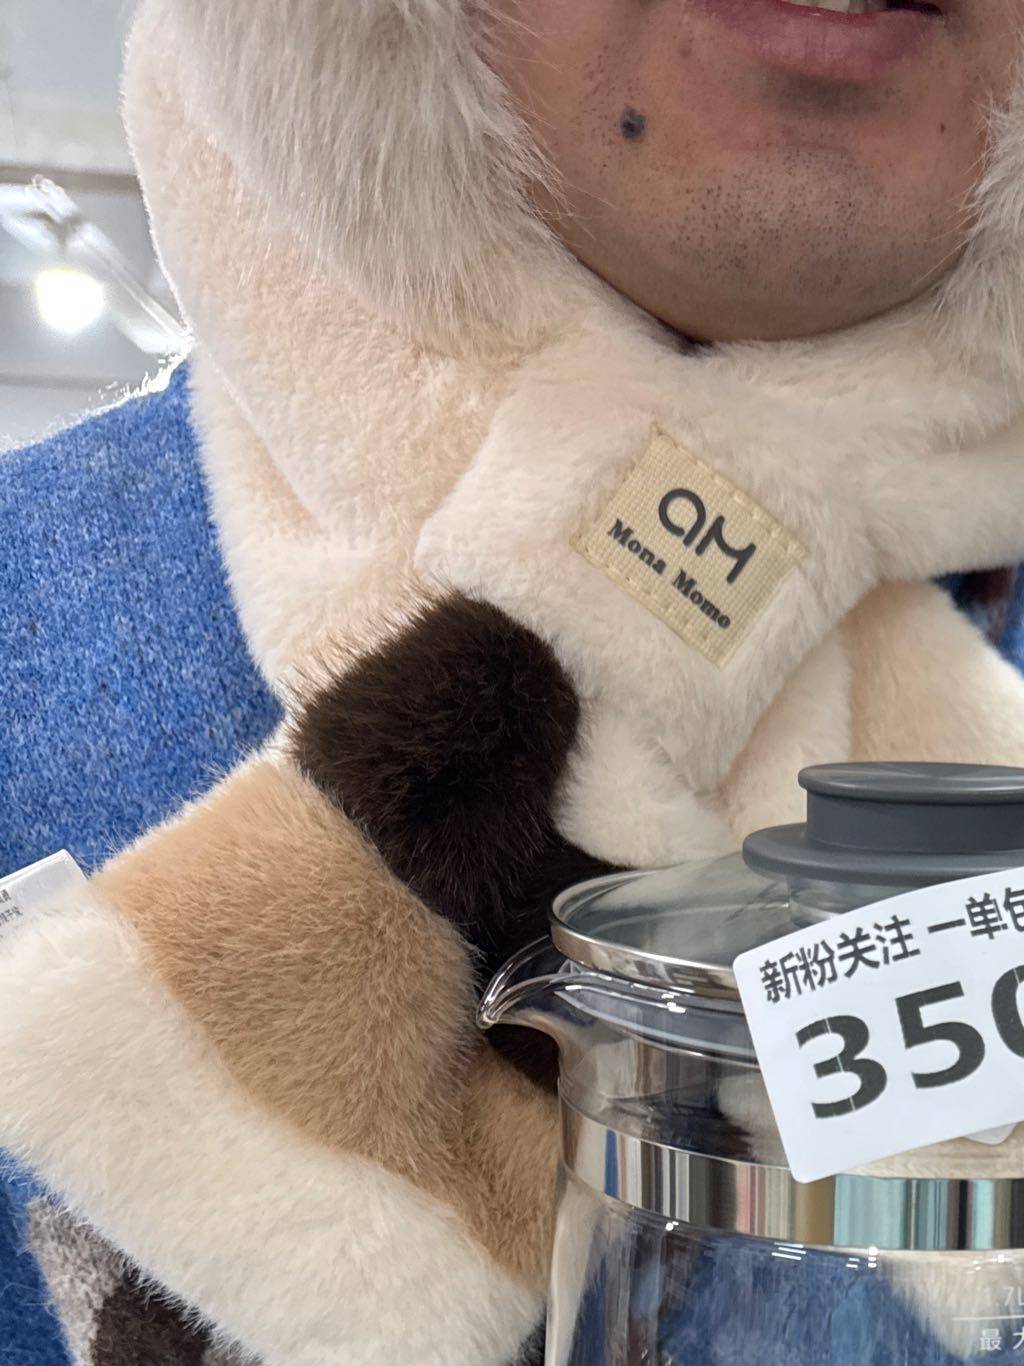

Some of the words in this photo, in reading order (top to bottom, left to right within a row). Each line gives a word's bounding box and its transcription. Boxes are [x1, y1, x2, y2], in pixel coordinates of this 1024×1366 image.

[607, 518, 667, 575] Mona
[672, 569, 731, 629] Momo
[759, 915, 921, 1003] 新粉关注
